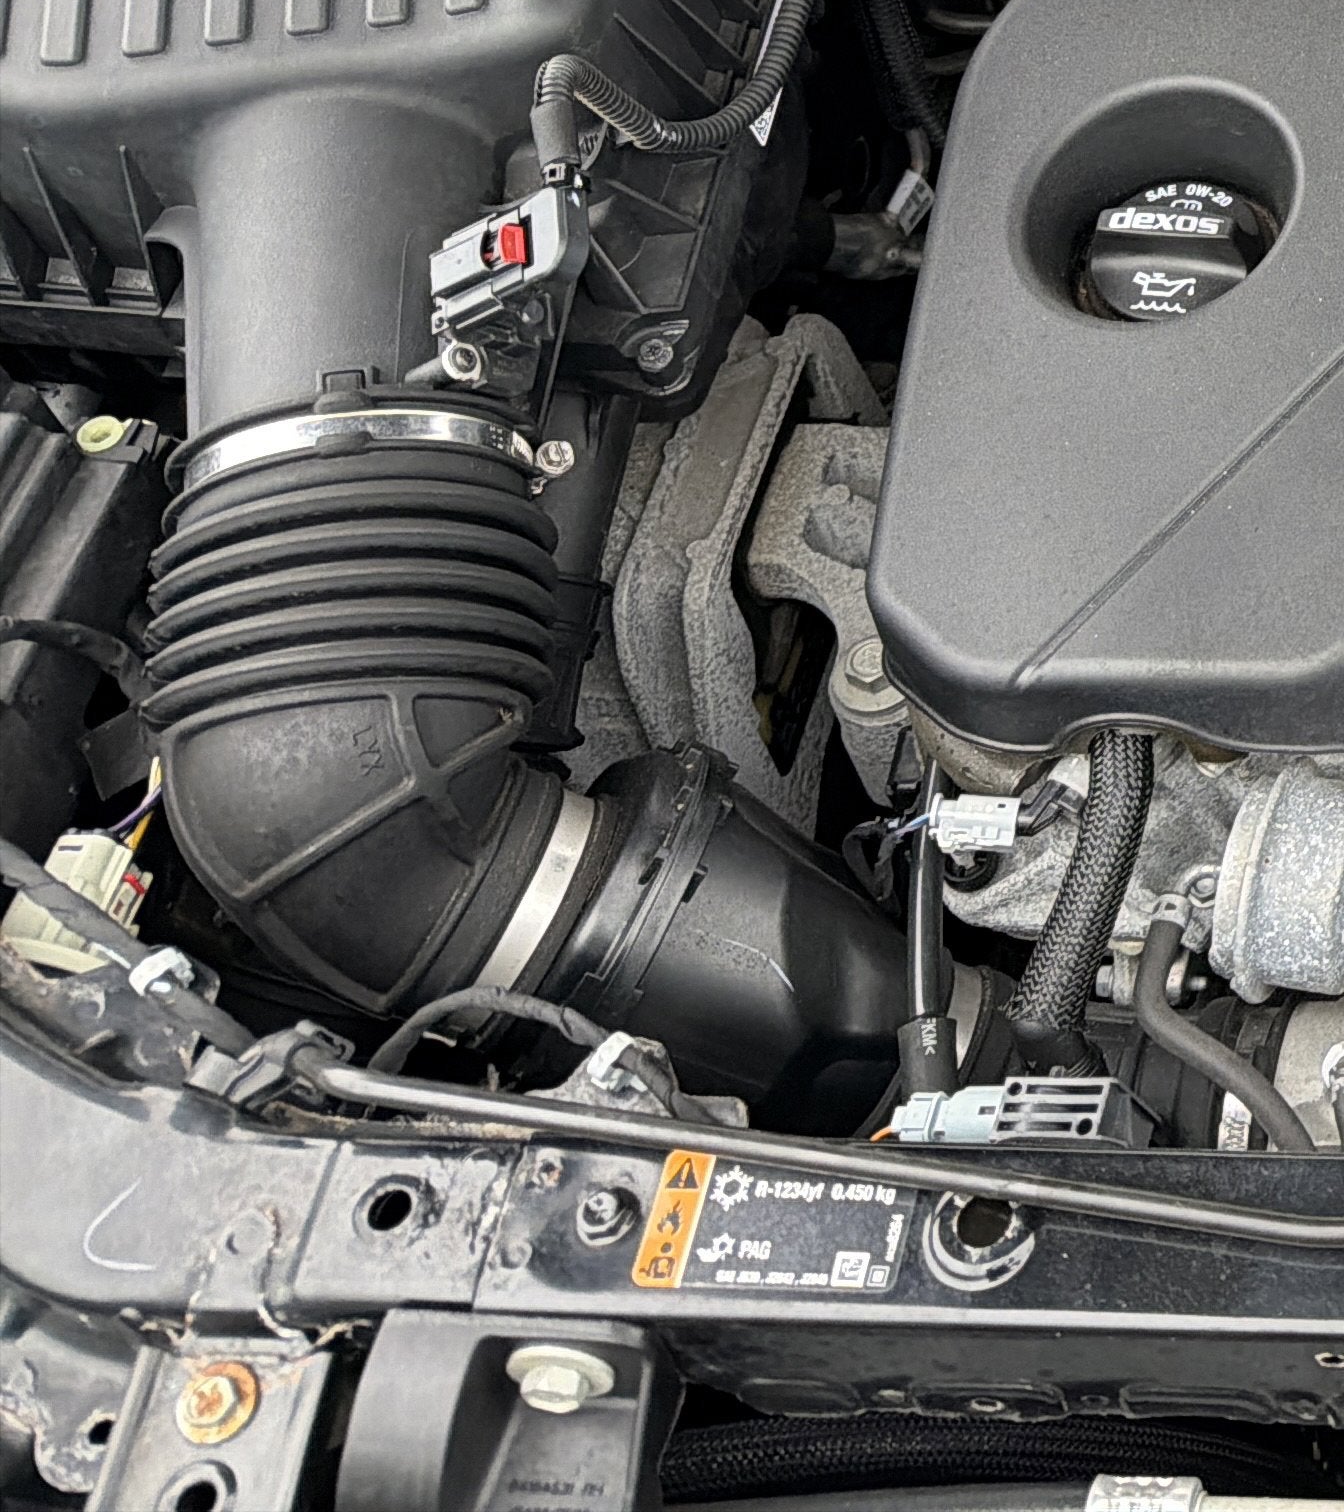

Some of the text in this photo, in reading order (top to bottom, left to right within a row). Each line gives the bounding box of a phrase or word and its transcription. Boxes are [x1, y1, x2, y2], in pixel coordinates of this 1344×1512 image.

[1145, 183, 1233, 208] SAE 0W-20
[1108, 207, 1225, 235] dexos
[738, 1239, 772, 1260] PAG
